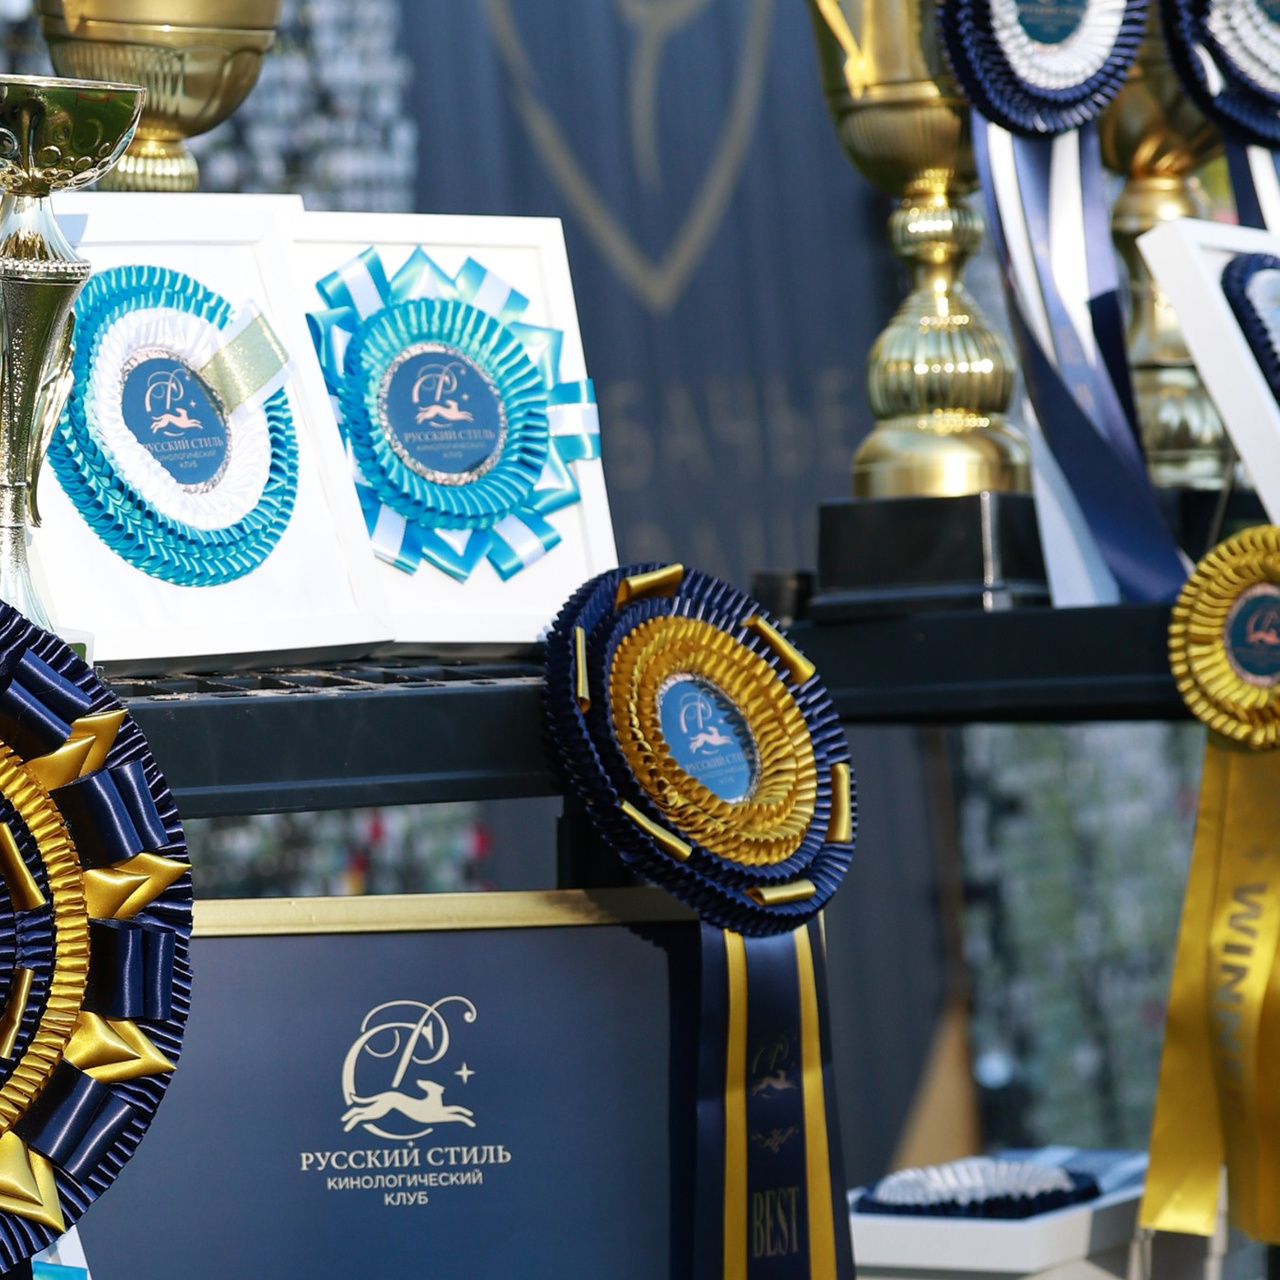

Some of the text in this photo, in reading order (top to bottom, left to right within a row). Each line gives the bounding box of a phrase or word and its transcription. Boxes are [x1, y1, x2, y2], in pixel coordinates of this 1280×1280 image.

[300, 1142, 512, 1171] РУССКИЙ СТИЛЬ
[327, 1168, 483, 1190] КИНОЛОГИЧЕСКИЙ
[384, 1191, 429, 1206] КЛУБ
[752, 1186, 800, 1258] BEST
